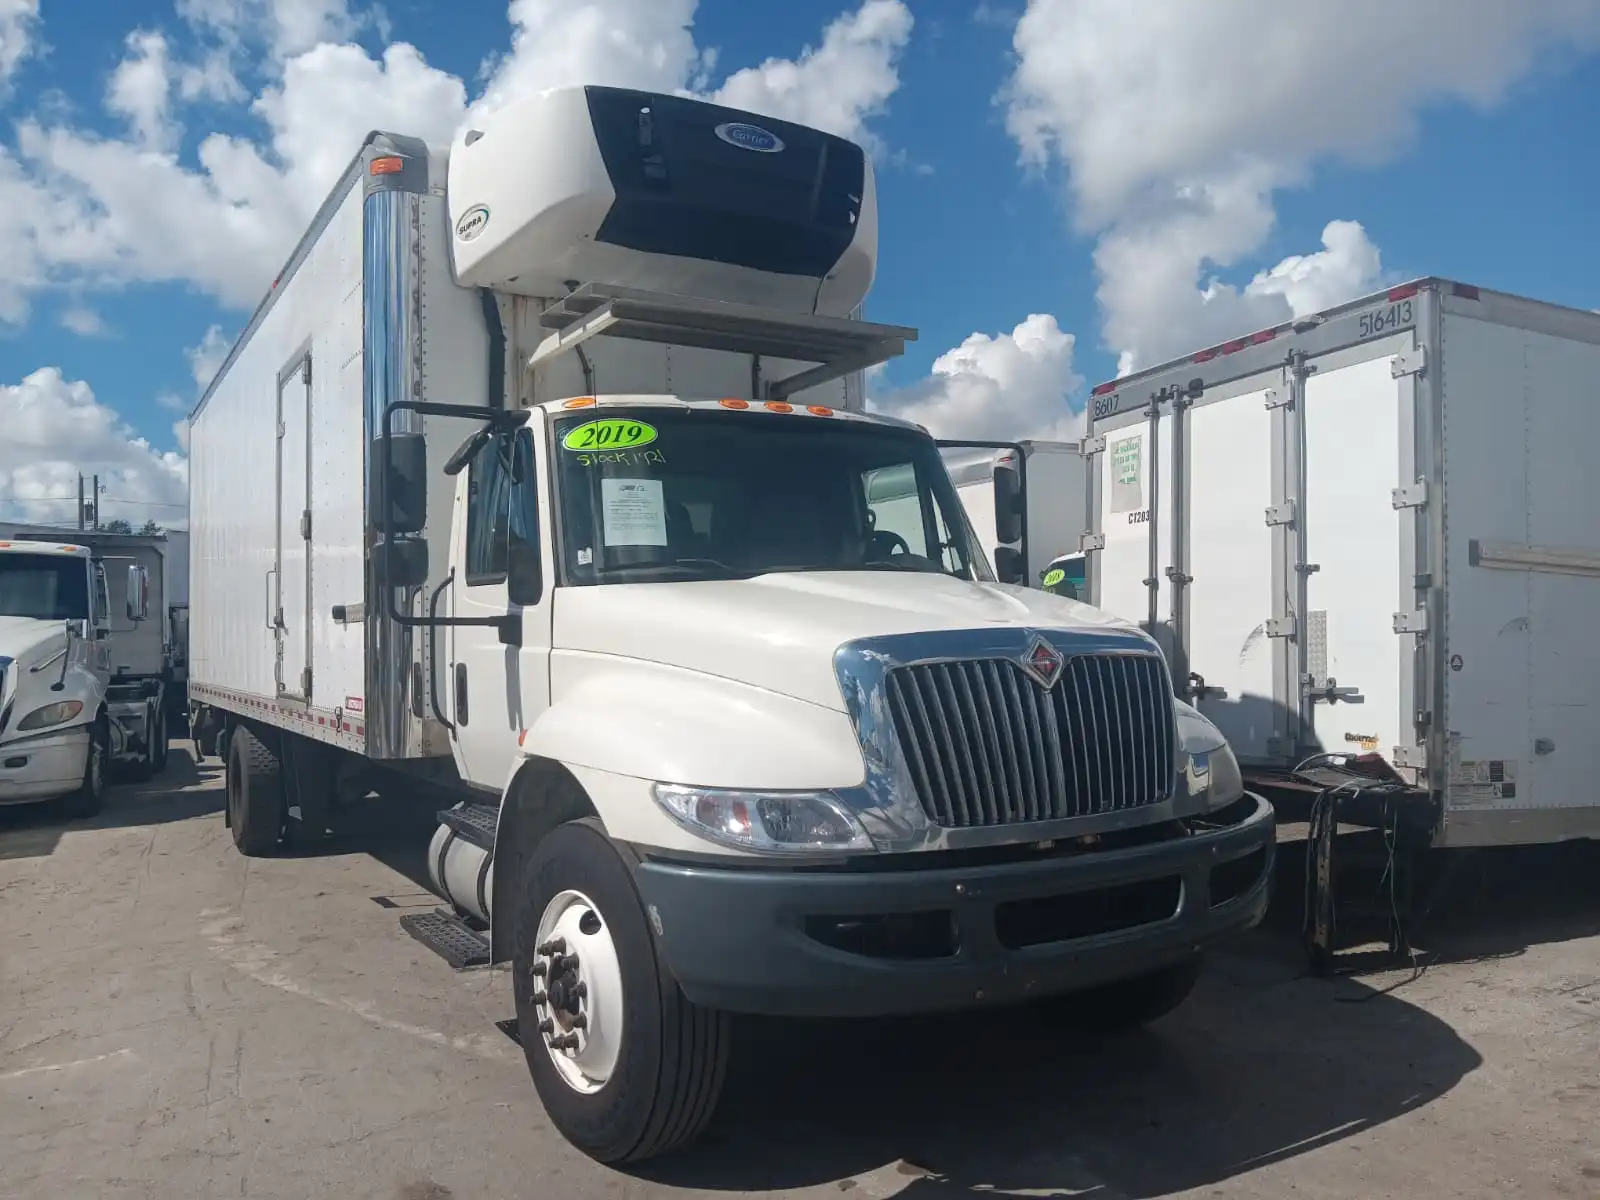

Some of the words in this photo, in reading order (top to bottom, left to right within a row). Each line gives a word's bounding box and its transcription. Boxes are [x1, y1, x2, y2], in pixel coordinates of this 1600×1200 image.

[459, 216, 482, 234] SUPRA
[1359, 300, 1412, 338] 516413
[1094, 394, 1119, 416] 8607
[580, 424, 642, 447] 2019
